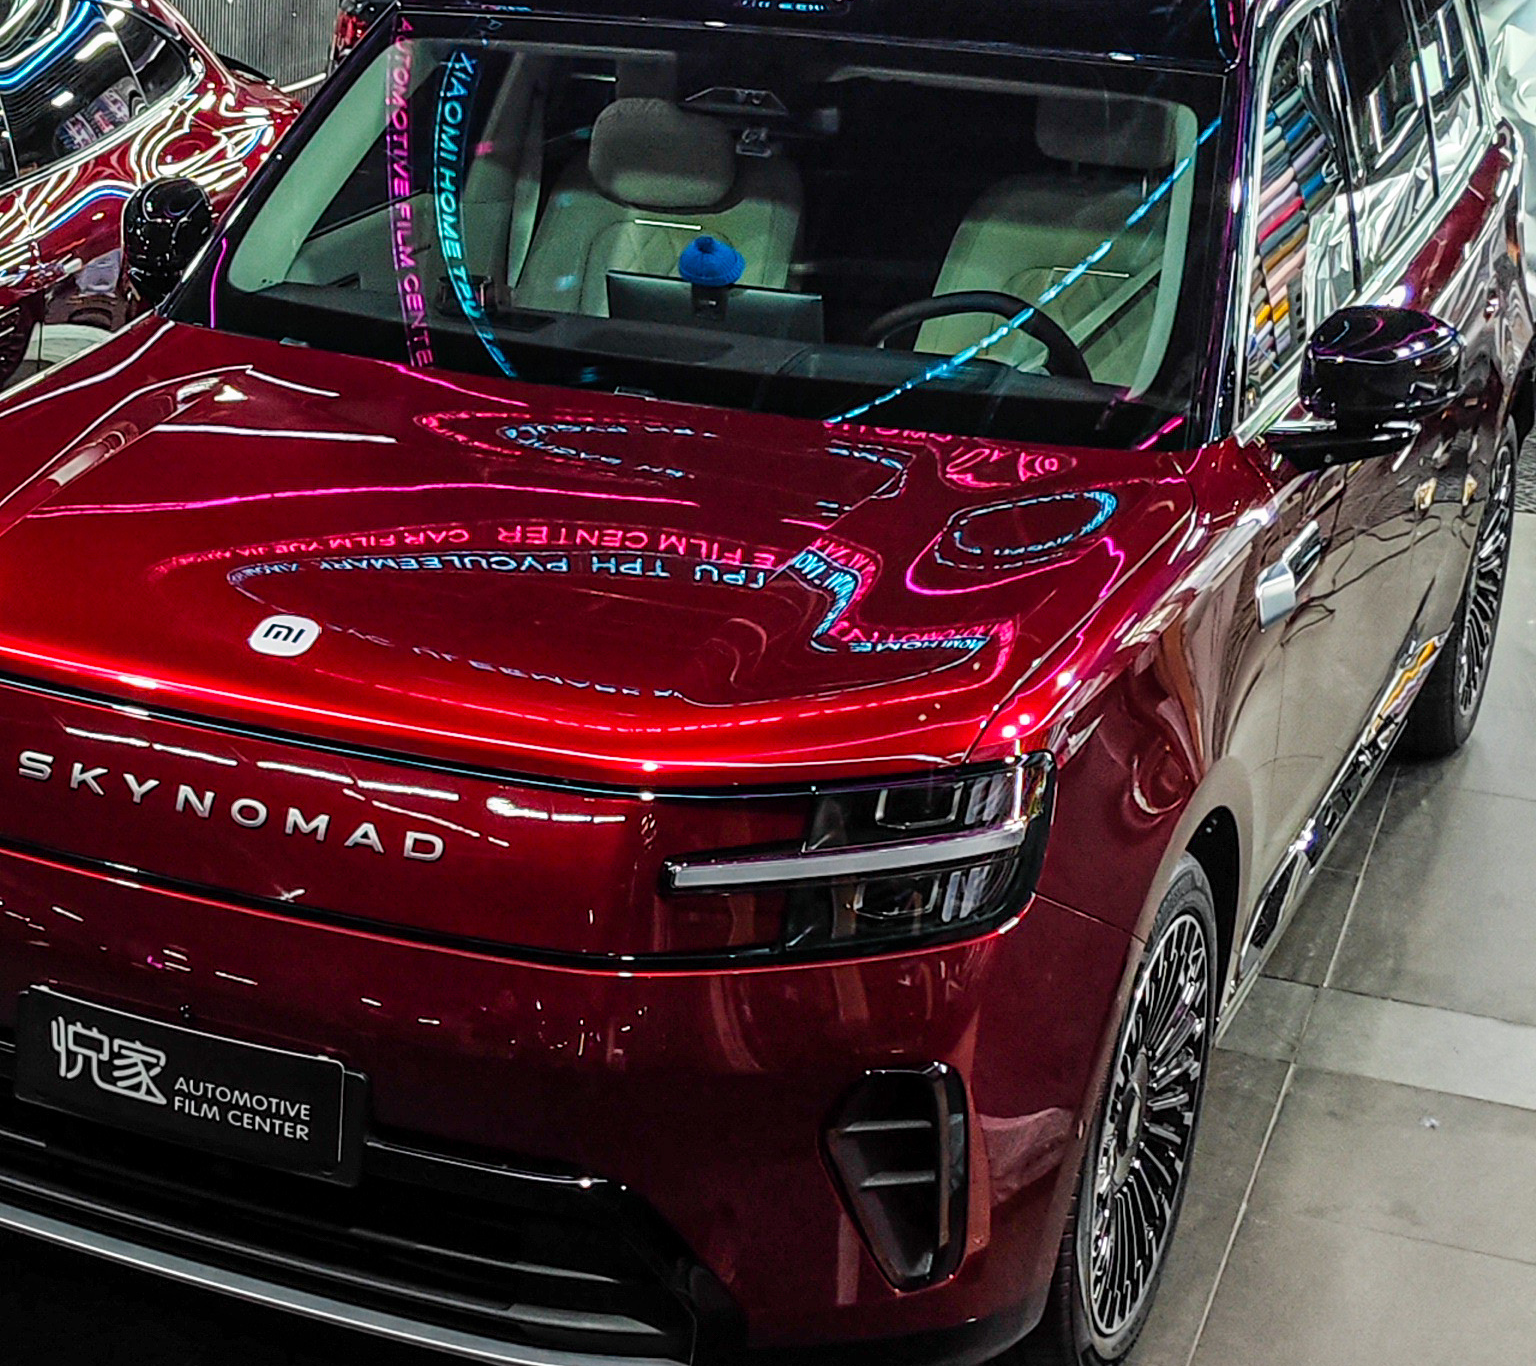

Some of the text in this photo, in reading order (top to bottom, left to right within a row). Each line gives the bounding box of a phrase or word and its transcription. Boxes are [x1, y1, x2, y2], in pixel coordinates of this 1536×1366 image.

[439, 167, 463, 260] HOME
[591, 555, 670, 578] TPH
[18, 750, 446, 863] SKYNOMAD
[51, 1015, 167, 1106] 悦家
[174, 1076, 311, 1122] AUTOMOTIVE
[174, 1096, 310, 1142] FILM CENTER
